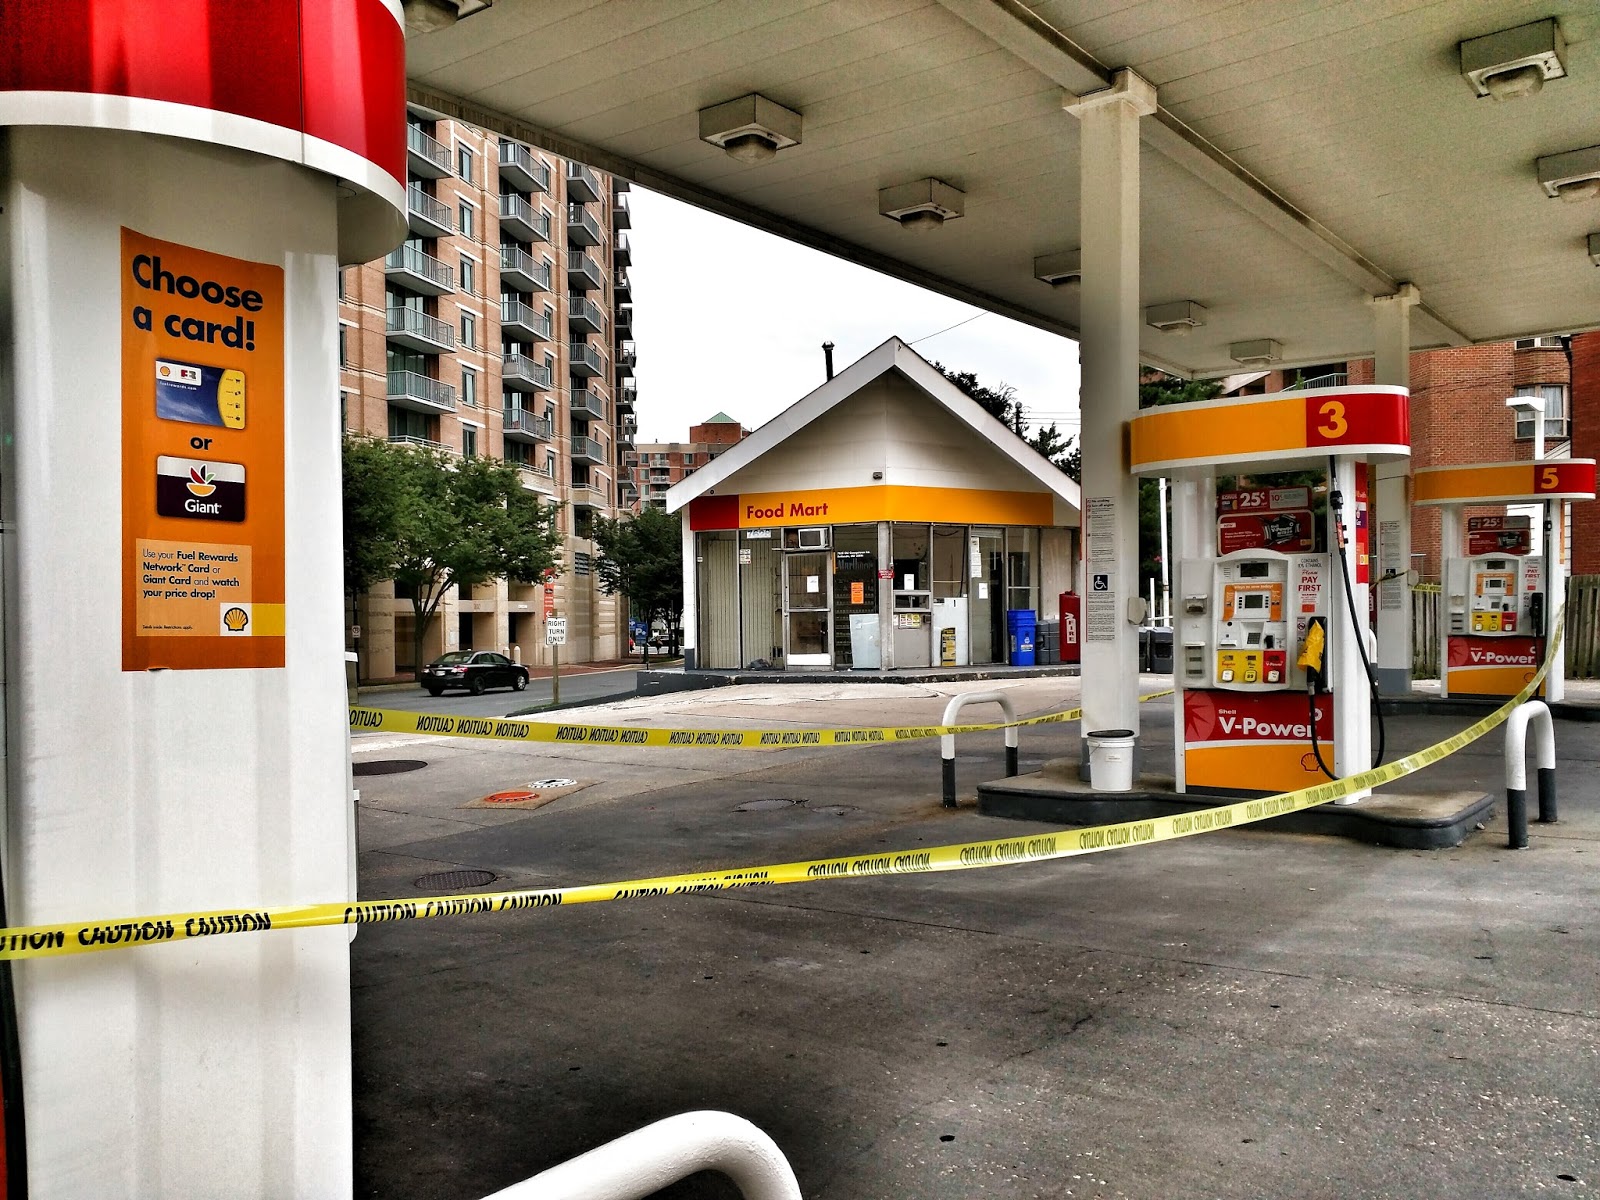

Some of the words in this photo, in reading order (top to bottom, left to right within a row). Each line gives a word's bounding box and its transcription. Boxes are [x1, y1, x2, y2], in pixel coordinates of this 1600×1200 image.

[132, 254, 263, 312] Choose
[133, 306, 152, 331] a
[164, 315, 255, 351] card!
[1318, 400, 1348, 439] 3
[190, 436, 213, 450] or
[1541, 468, 1559, 489] 5
[184, 499, 220, 514] Giant
[747, 503, 784, 519] Food
[790, 503, 828, 517] Mart
[143, 549, 156, 558] Use
[158, 552, 174, 561] your
[177, 551, 195, 560] Fuel
[198, 552, 239, 562] Rewards
[188, 564, 210, 573] Card
[143, 574, 166, 584] Giant
[169, 576, 191, 585] Card
[194, 577, 209, 585] and
[212, 578, 240, 586] watch
[143, 590, 163, 598] your
[165, 588, 188, 599] price
[190, 589, 216, 600] drop!
[1471, 652, 1535, 663] V-Power
[1218, 717, 1317, 738] V-Power
[78, 920, 174, 945] CAUTION
[185, 912, 272, 937] CAUTION
[343, 903, 417, 923] CAUTION
[425, 897, 492, 916] CAUTION
[500, 893, 562, 910] CAUTION
